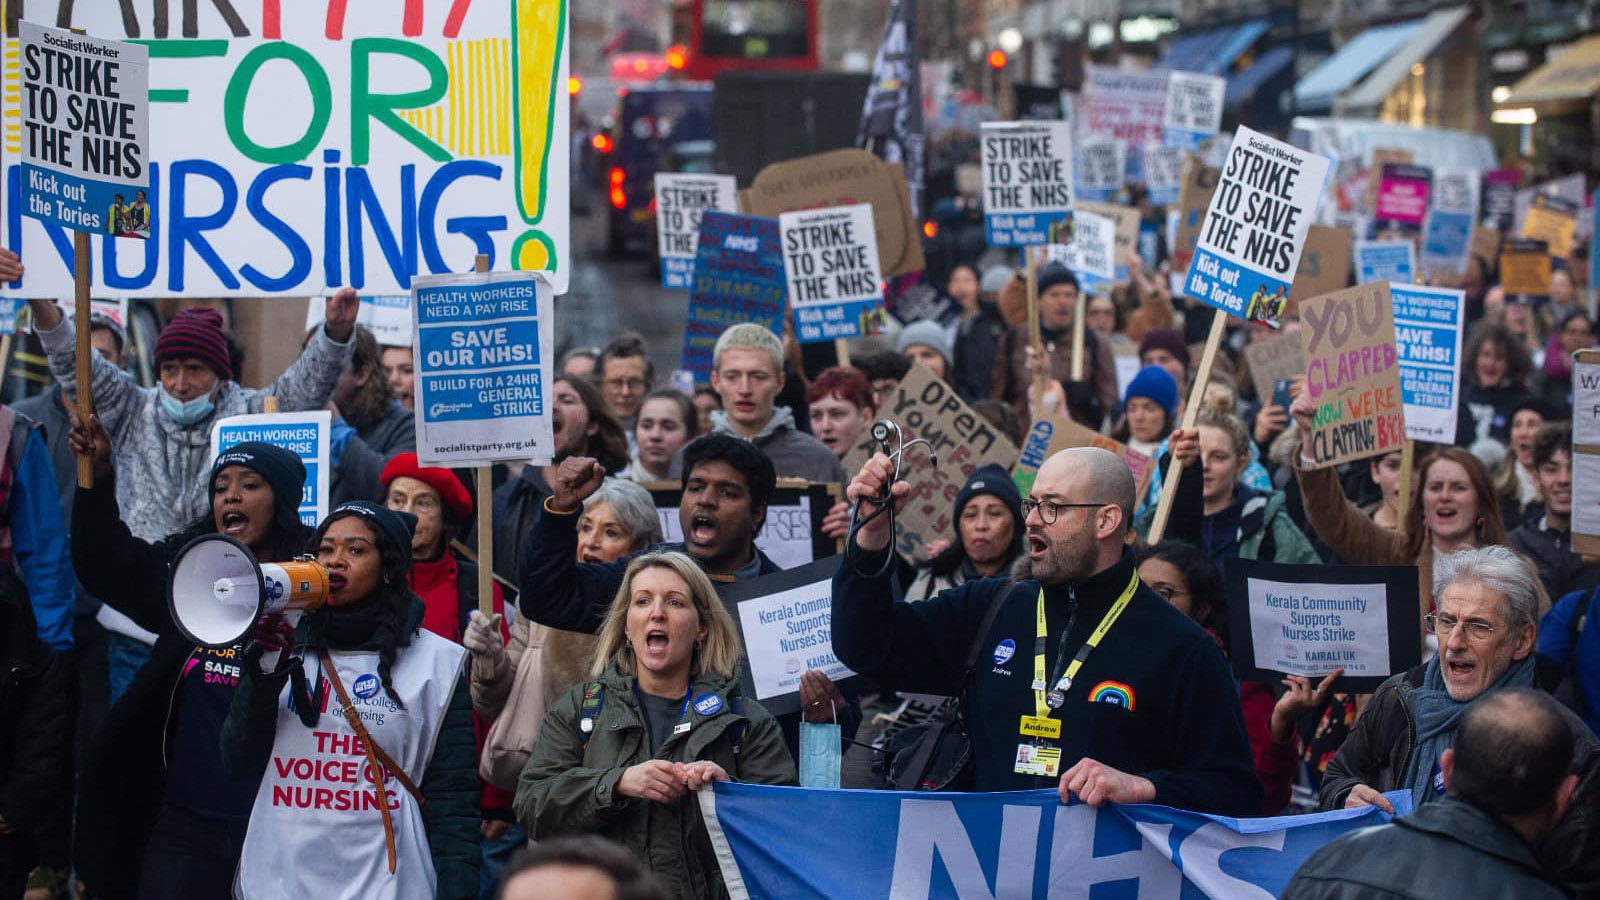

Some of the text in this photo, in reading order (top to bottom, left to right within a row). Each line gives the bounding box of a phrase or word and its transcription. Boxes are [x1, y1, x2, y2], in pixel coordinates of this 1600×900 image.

[43, 33, 119, 59] Socialist Worker
[24, 43, 120, 99] STRIKE
[24, 81, 136, 140] TO SAVE
[24, 120, 142, 180] THE NHS
[986, 136, 1053, 161] STRIKE
[988, 163, 1012, 185] TO
[1018, 160, 1065, 185] SAVE
[1226, 146, 1300, 201] STRIKE
[29, 169, 87, 204] Kick out
[661, 187, 720, 210] STRIKE
[988, 183, 1069, 208] THE NHS
[29, 195, 101, 230] the Tories
[662, 210, 684, 231] TO
[1216, 178, 1302, 240] TO SAVE
[663, 233, 695, 254] THE
[786, 221, 855, 252] STRIKE
[1205, 211, 1295, 274] THE NHS
[789, 253, 815, 276] TO
[821, 245, 869, 274] SAVE
[1196, 254, 1241, 288] Kick out
[420, 292, 468, 305] HEALTH
[470, 286, 533, 303] WORKERS
[792, 276, 832, 302] THE
[836, 270, 877, 297] NHS
[1190, 274, 1244, 313] the Tories
[426, 300, 529, 318] NEED A PAY RISE
[1303, 290, 1383, 354] YOU
[451, 327, 508, 348] SAVE
[427, 344, 534, 368] OUR NHS!
[1409, 345, 1451, 364] NHS!
[1307, 341, 1397, 399] CLAPPED
[430, 373, 540, 392] BUILD FOR A 24HR
[1403, 379, 1450, 396] GENERAL
[478, 387, 541, 403] GENERAL
[1414, 393, 1449, 408] STRIKE
[493, 400, 541, 416] STRIKE
[1311, 400, 1343, 431] NOW
[221, 428, 317, 443] HEALTH WORKERS
[288, 441, 313, 453] RISE
[434, 439, 537, 454] socialistparty.org.uk
[1313, 418, 1376, 464] CLAPPING
[758, 605, 794, 625] Kerala
[1265, 593, 1367, 614] Kerala Community
[786, 612, 832, 636] Supports
[1290, 611, 1342, 629] Supports
[779, 632, 817, 654] Nurses
[1281, 625, 1356, 642] Nurses Strike
[806, 653, 838, 669] KAIRAL
[1305, 650, 1356, 662] KAIRALI UK
[205, 660, 241, 678] SAFE
[1024, 722, 1058, 734] Andrew
[312, 731, 367, 757] THE
[273, 756, 359, 784] VOICE
[272, 784, 401, 812] NURSING
[889, 799, 1287, 900] NHS
